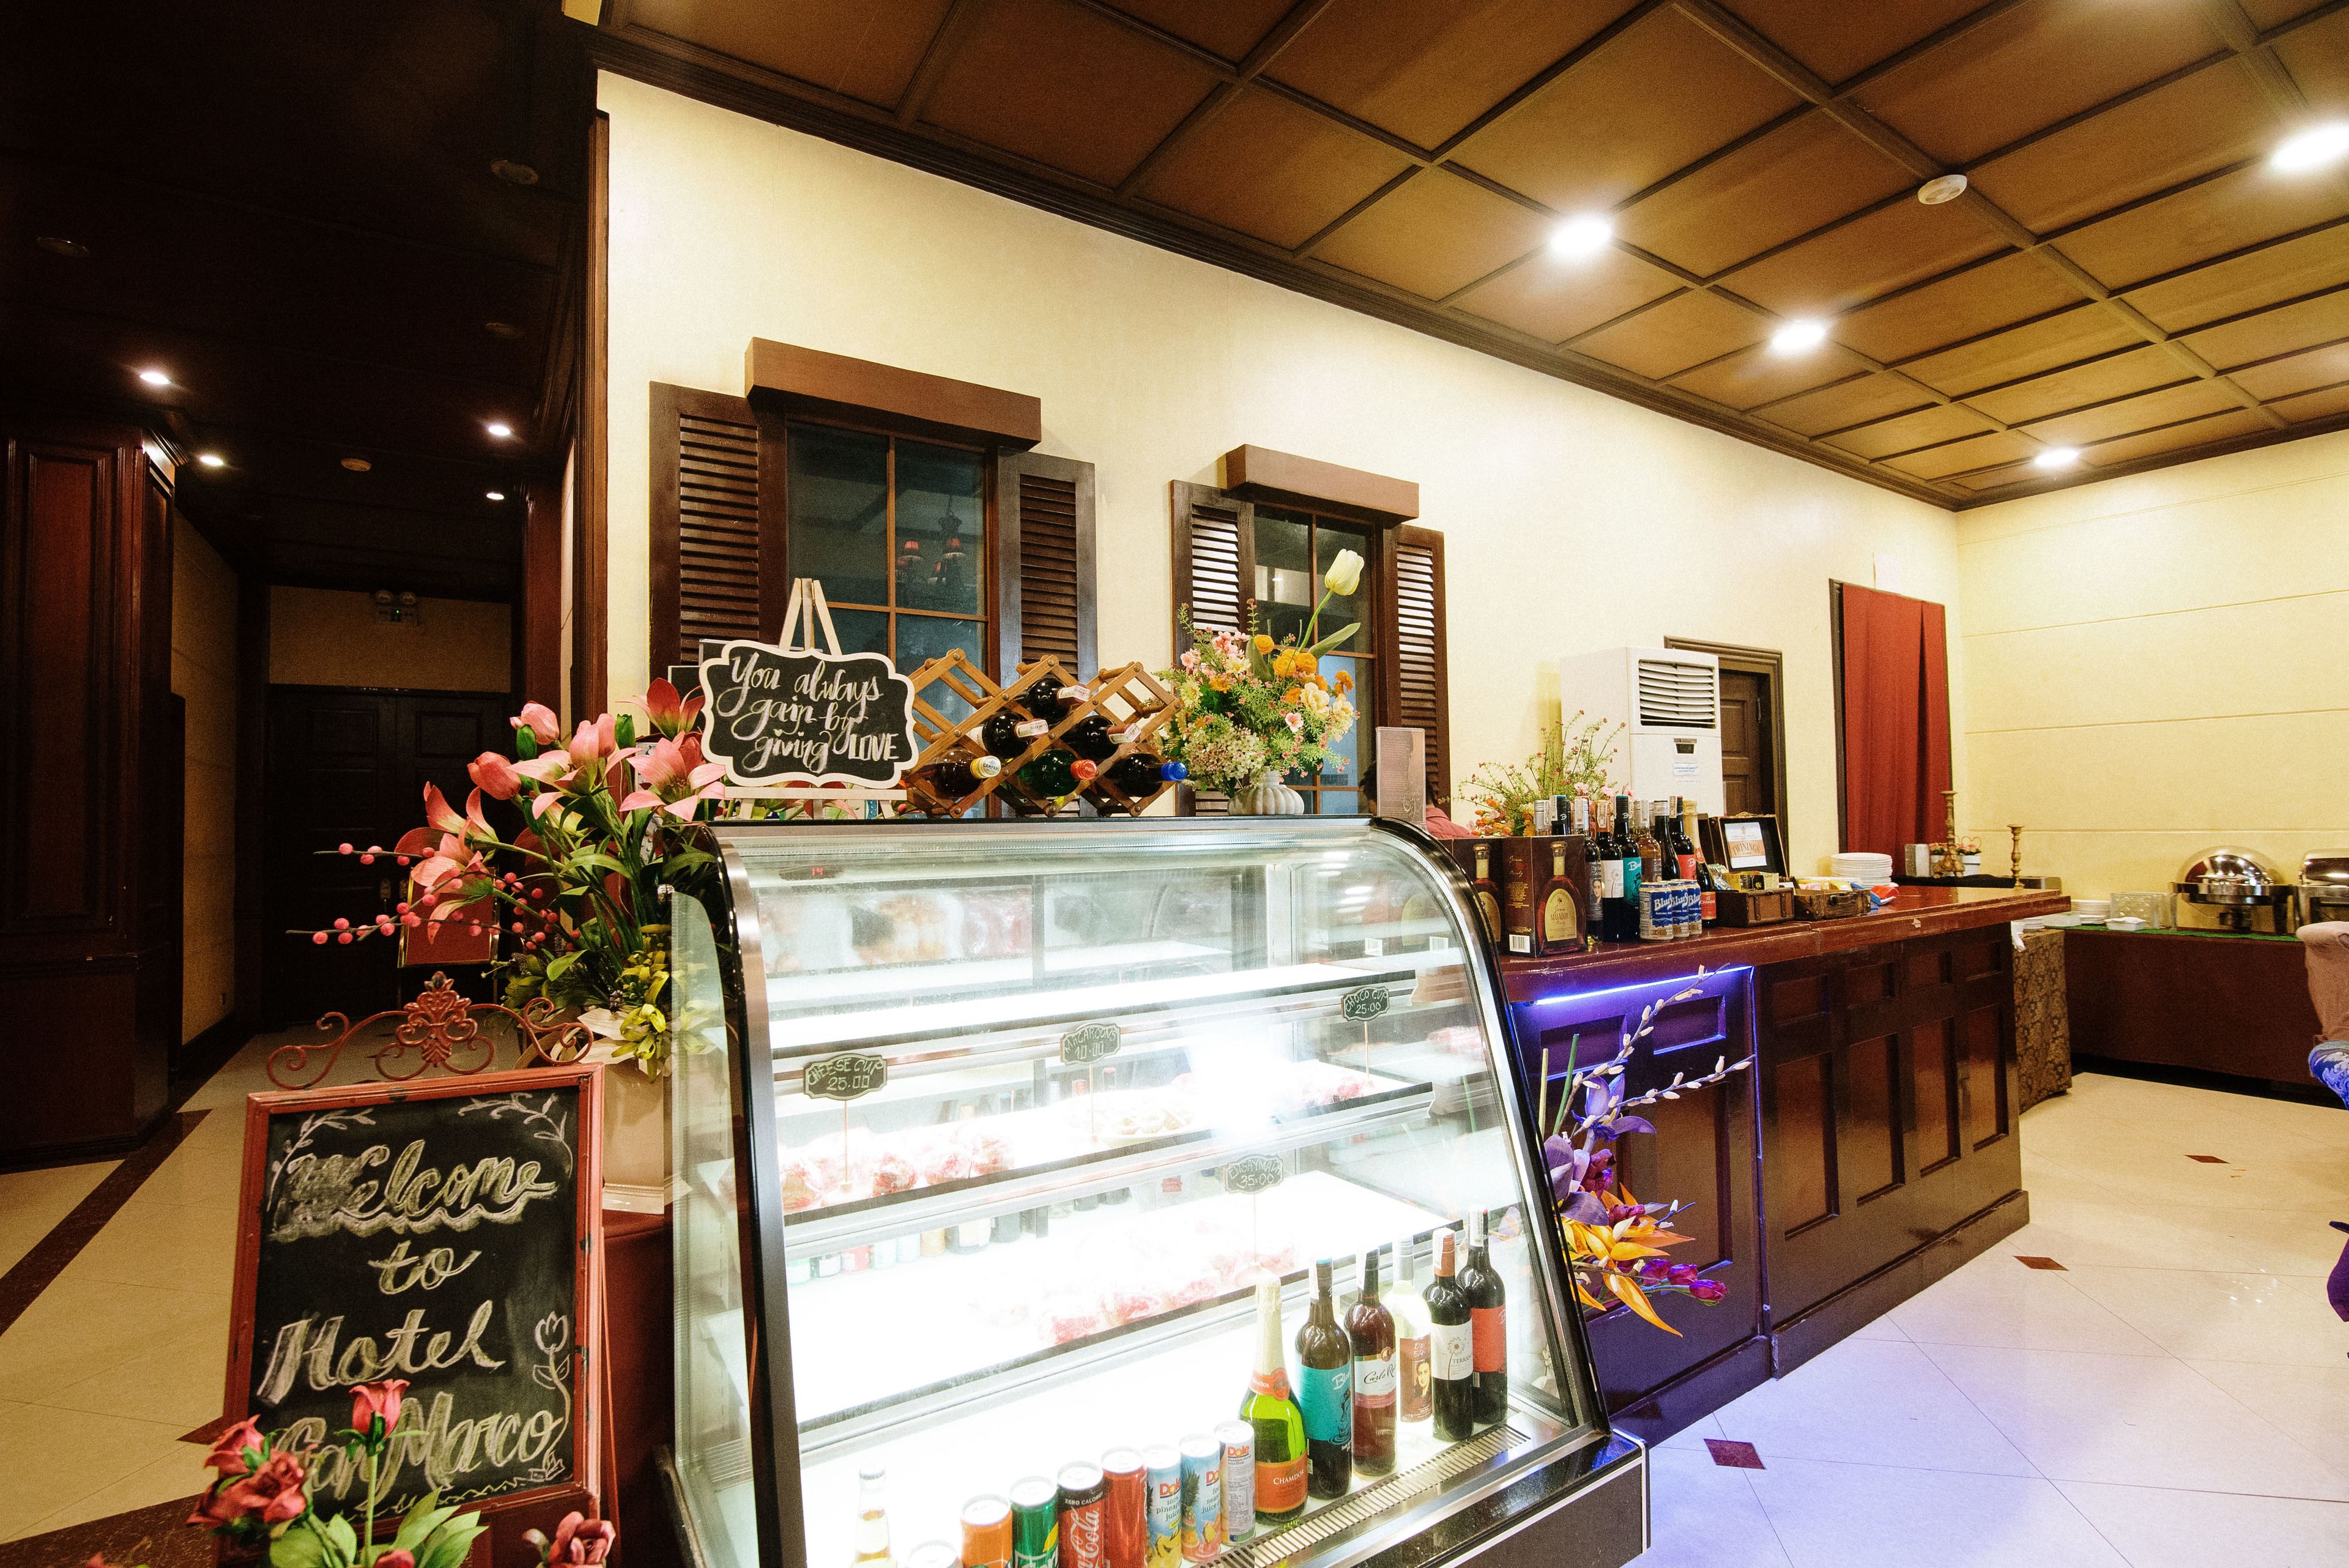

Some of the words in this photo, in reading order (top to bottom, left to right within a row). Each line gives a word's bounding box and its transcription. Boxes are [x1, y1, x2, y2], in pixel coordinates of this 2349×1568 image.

[716, 652, 781, 717] You
[795, 660, 884, 723] always
[731, 696, 817, 740] gain
[820, 702, 868, 754] by
[743, 730, 832, 774] giving
[848, 734, 899, 762] LOVE
[1732, 842, 1761, 855] TWININGS
[1346, 990, 1370, 1013] CHOCO
[1371, 990, 1387, 1003] CUP
[1355, 1002, 1381, 1014] 25.00
[1064, 1027, 1116, 1053] MACAROONS
[807, 1057, 852, 1085] CHEESE
[854, 1059, 884, 1076] CUP
[826, 1075, 870, 1091] 25.00
[273, 1139, 557, 1224] Welcome
[1228, 1158, 1282, 1180] ENSAYMADA
[368, 1241, 481, 1295] to
[256, 1300, 505, 1406] Hotel
[1364, 1369, 1386, 1384] Carlo
[355, 1391, 563, 1511] Marco
[1228, 1446, 1250, 1457] Dole
[1273, 1469, 1304, 1485] CHAMDOR
